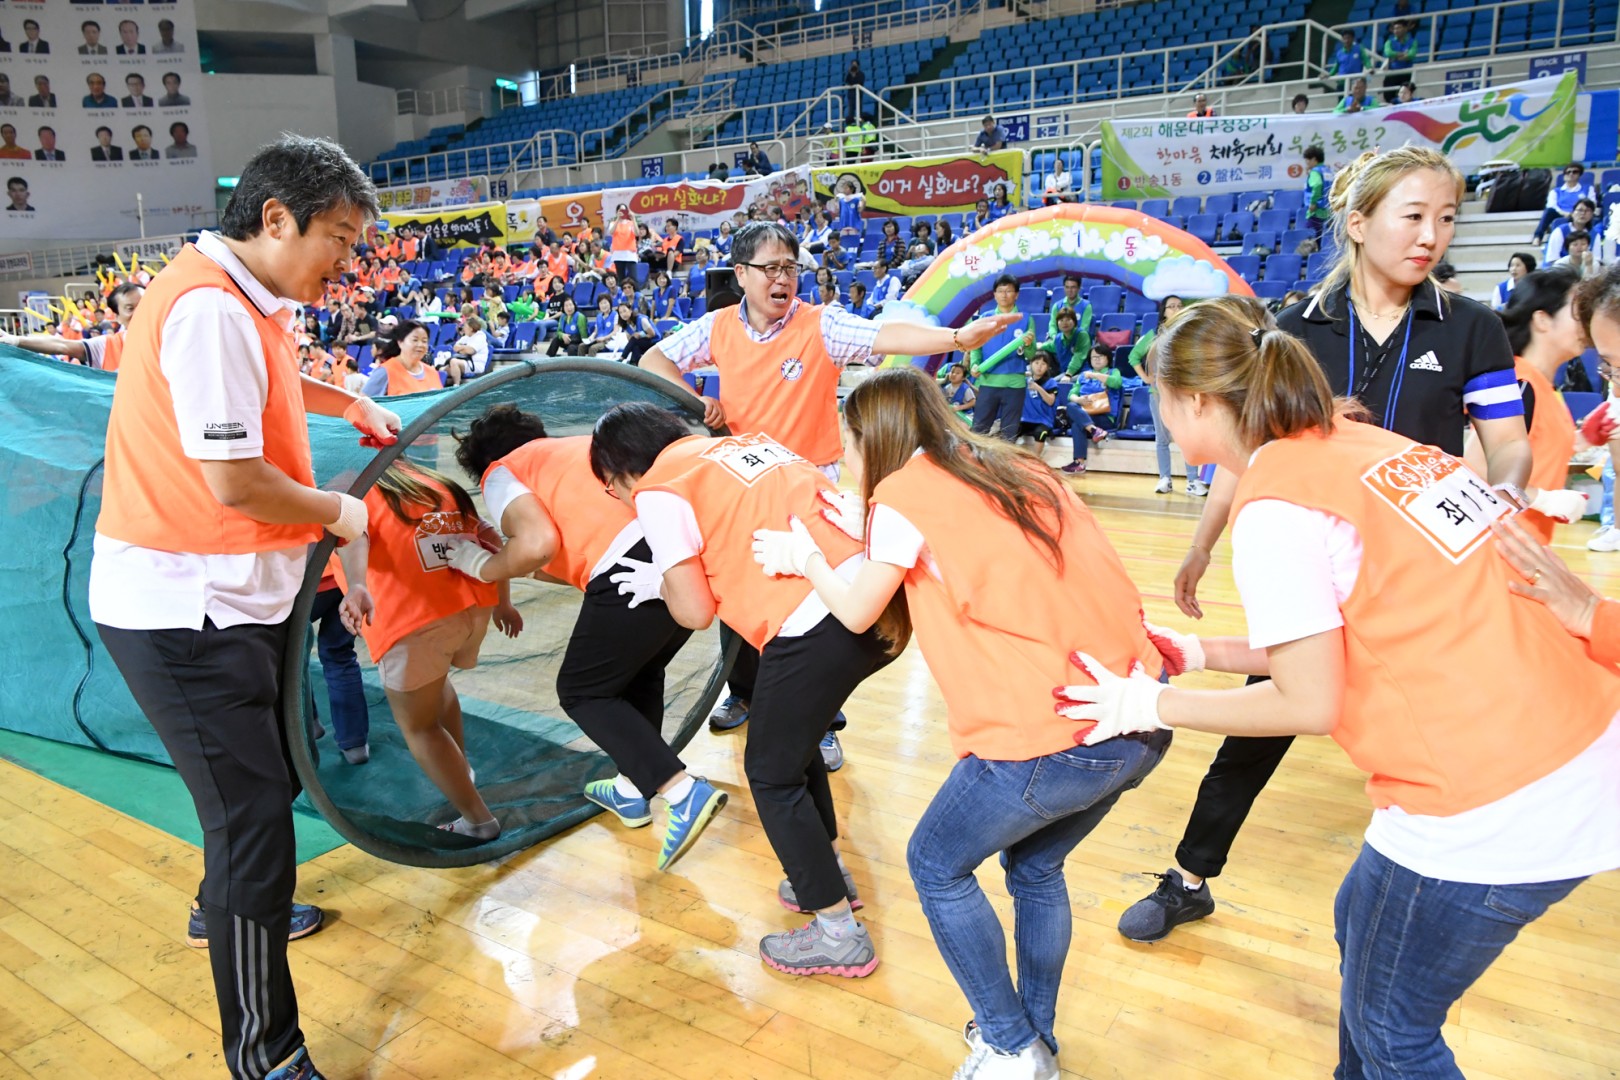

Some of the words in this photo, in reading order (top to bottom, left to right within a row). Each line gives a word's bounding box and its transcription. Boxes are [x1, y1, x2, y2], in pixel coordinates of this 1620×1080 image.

[1121, 126, 1153, 139] 제2회
[1156, 146, 1202, 165] 한마음
[1209, 133, 1282, 164] 체육대회
[644, 166, 661, 177] 2-3
[879, 179, 911, 194] 이거
[918, 171, 980, 199] 실화냐?
[640, 194, 669, 208] 이거
[673, 187, 728, 209] 실화냐?
[964, 255, 980, 271] 반
[1017, 235, 1029, 255] 송
[1125, 236, 1137, 257] 동
[1409, 362, 1443, 372] adidas
